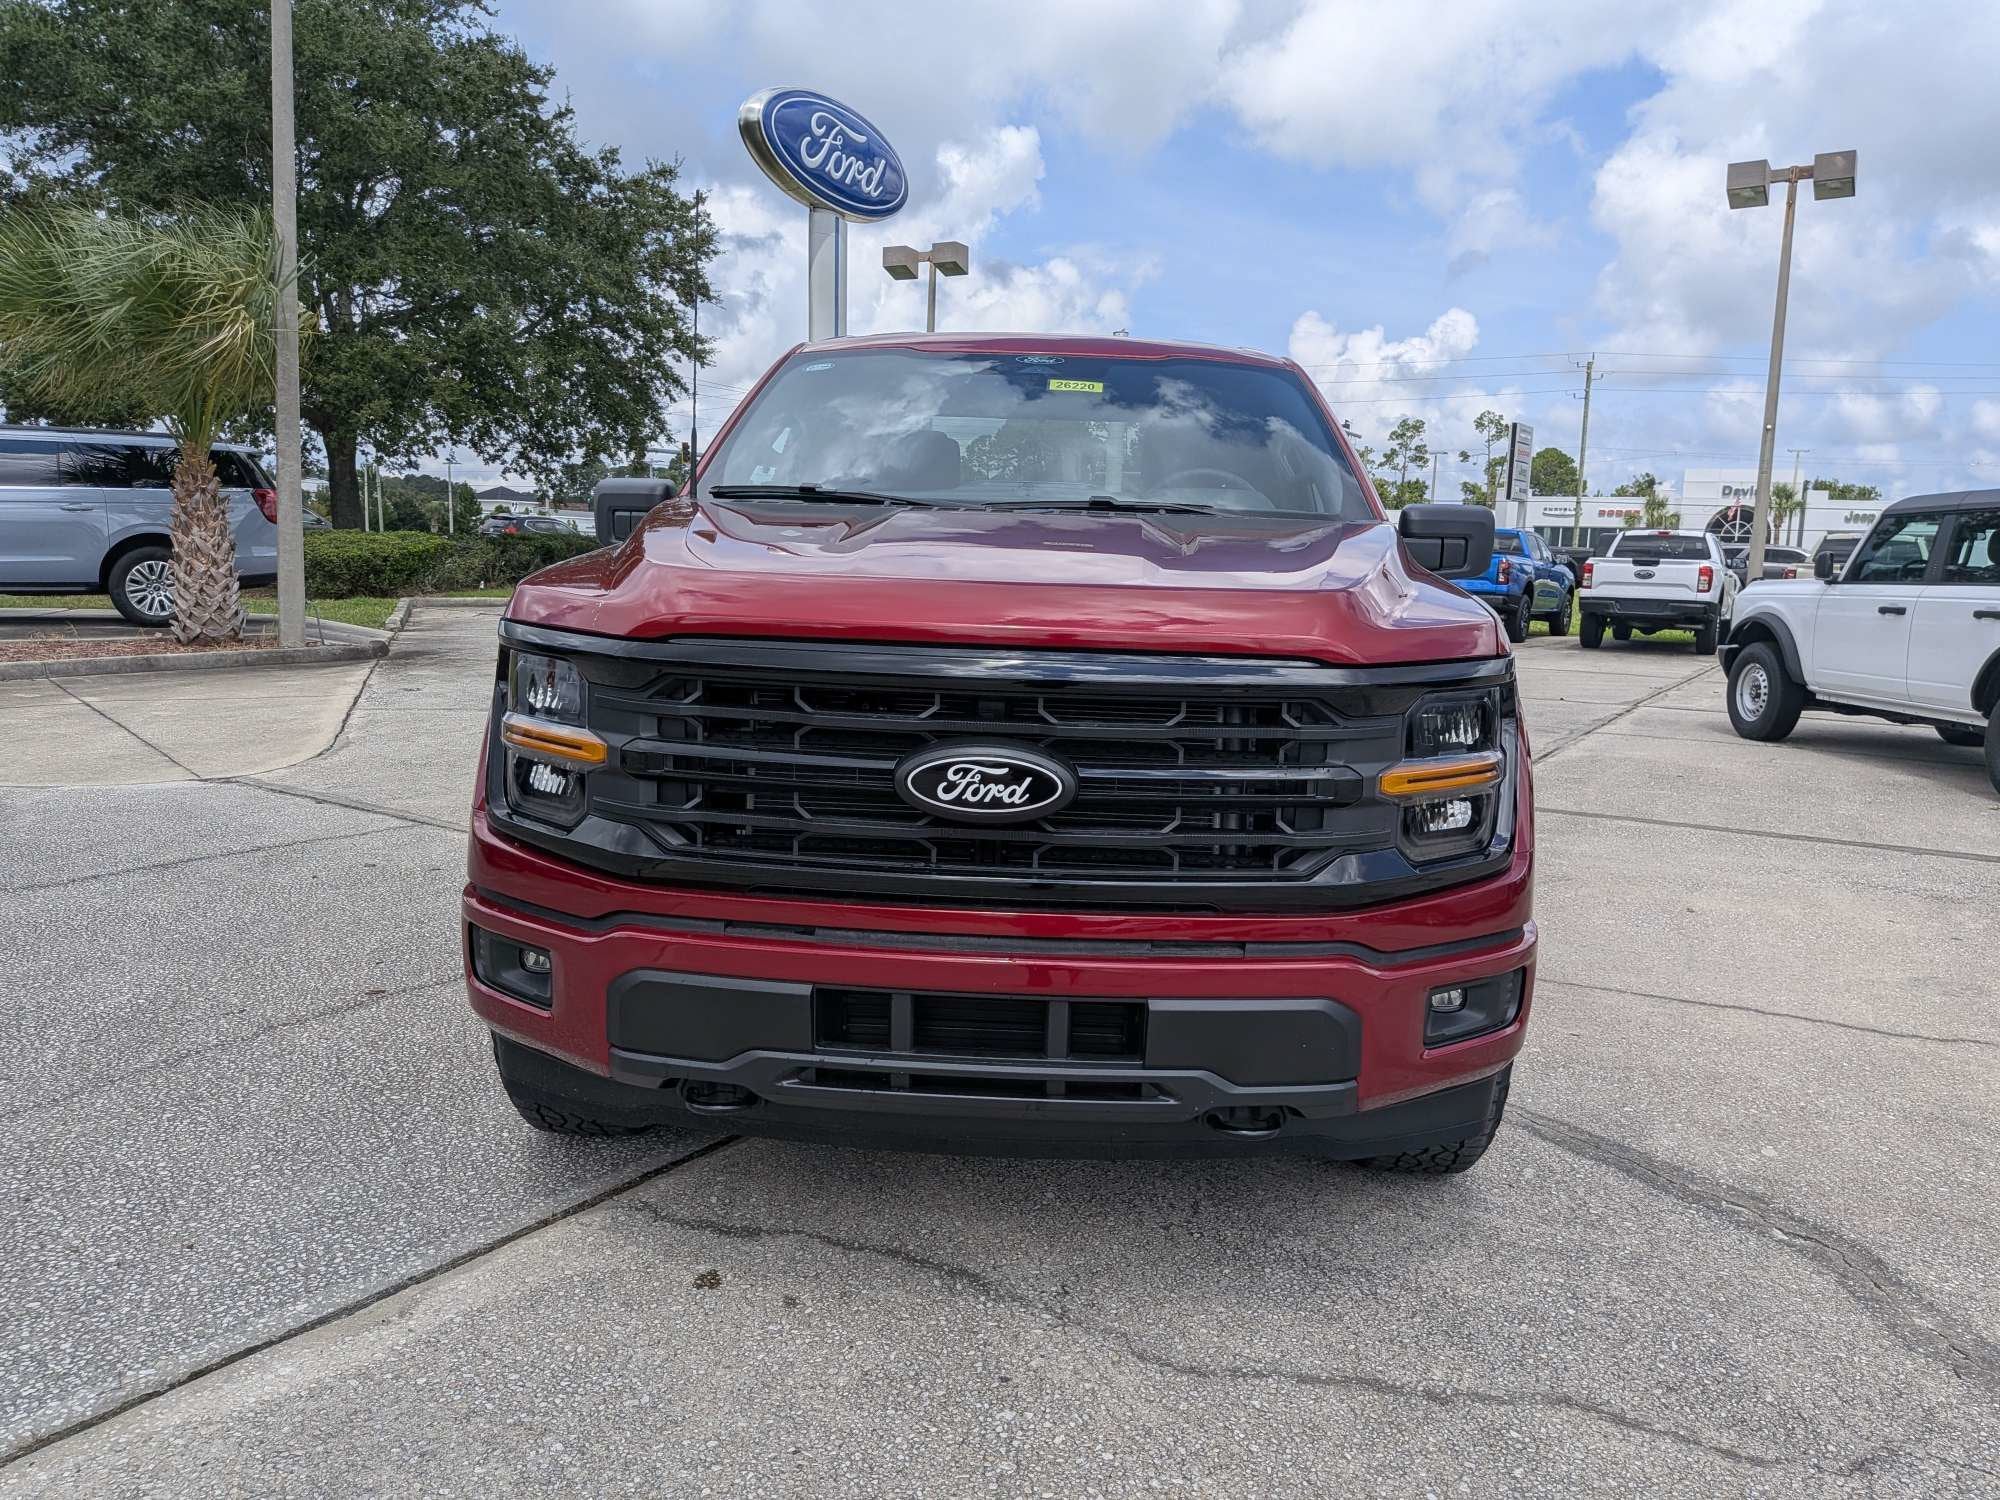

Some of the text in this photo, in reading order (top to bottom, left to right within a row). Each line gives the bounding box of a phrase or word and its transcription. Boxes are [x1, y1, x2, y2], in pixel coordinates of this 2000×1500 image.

[801, 112, 886, 197] Ford
[1056, 381, 1095, 390] 26220
[1721, 485, 1757, 497] Davi
[1844, 510, 1876, 526] Jeep
[937, 763, 1033, 804] Ford
